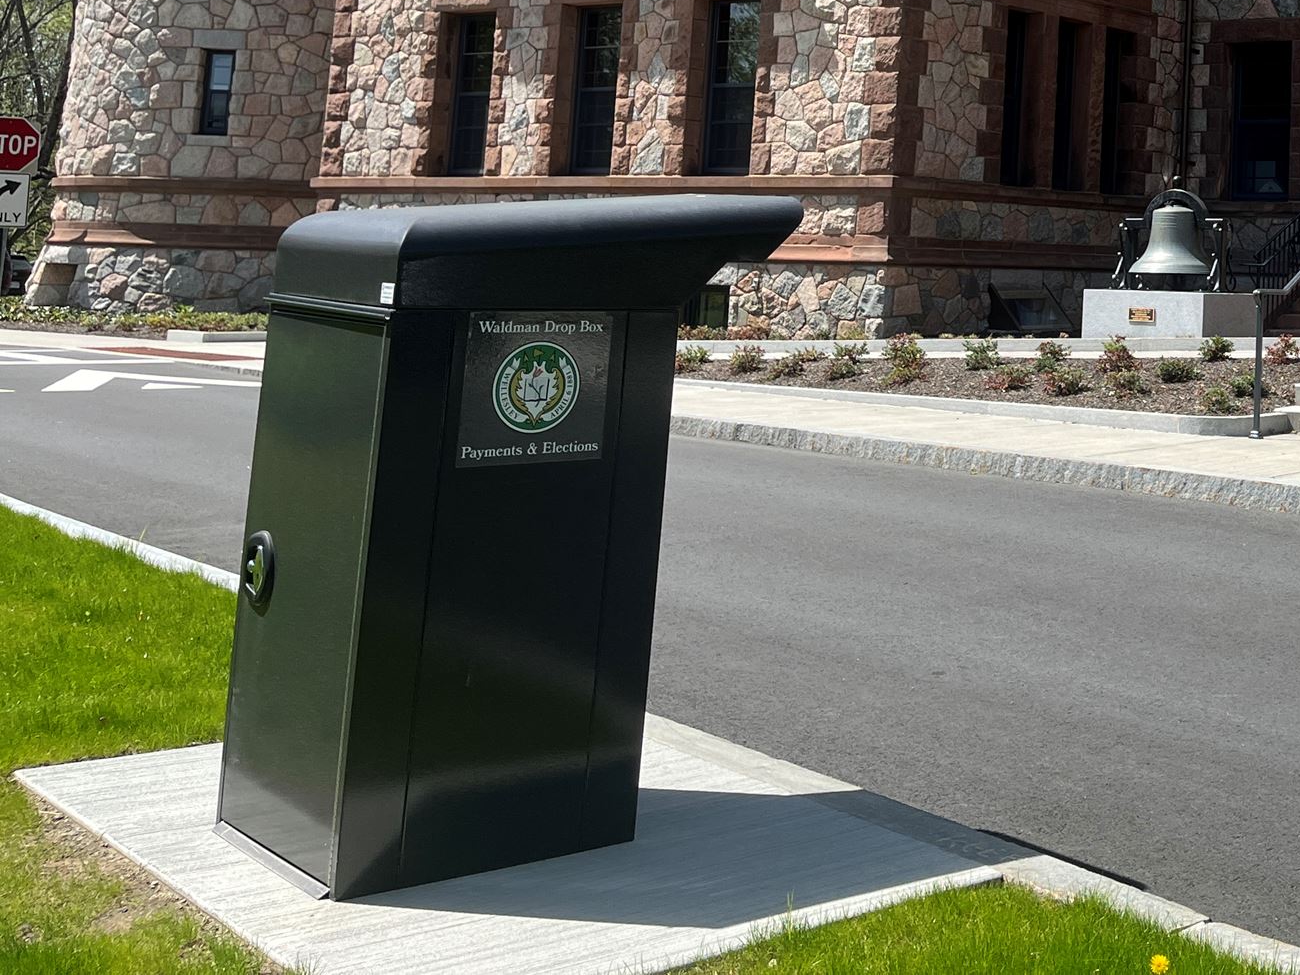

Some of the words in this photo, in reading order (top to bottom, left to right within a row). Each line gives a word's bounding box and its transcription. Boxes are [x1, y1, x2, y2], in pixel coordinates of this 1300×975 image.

[0, 134, 37, 155] TOP
[478, 321, 540, 334] Waldman
[544, 321, 576, 334] Drop
[580, 321, 604, 333] Box
[500, 372, 518, 420] WELLESLEY
[550, 398, 569, 419] APRIL
[461, 446, 523, 460] Payments
[527, 443, 538, 455] &
[542, 441, 599, 454] Elections
